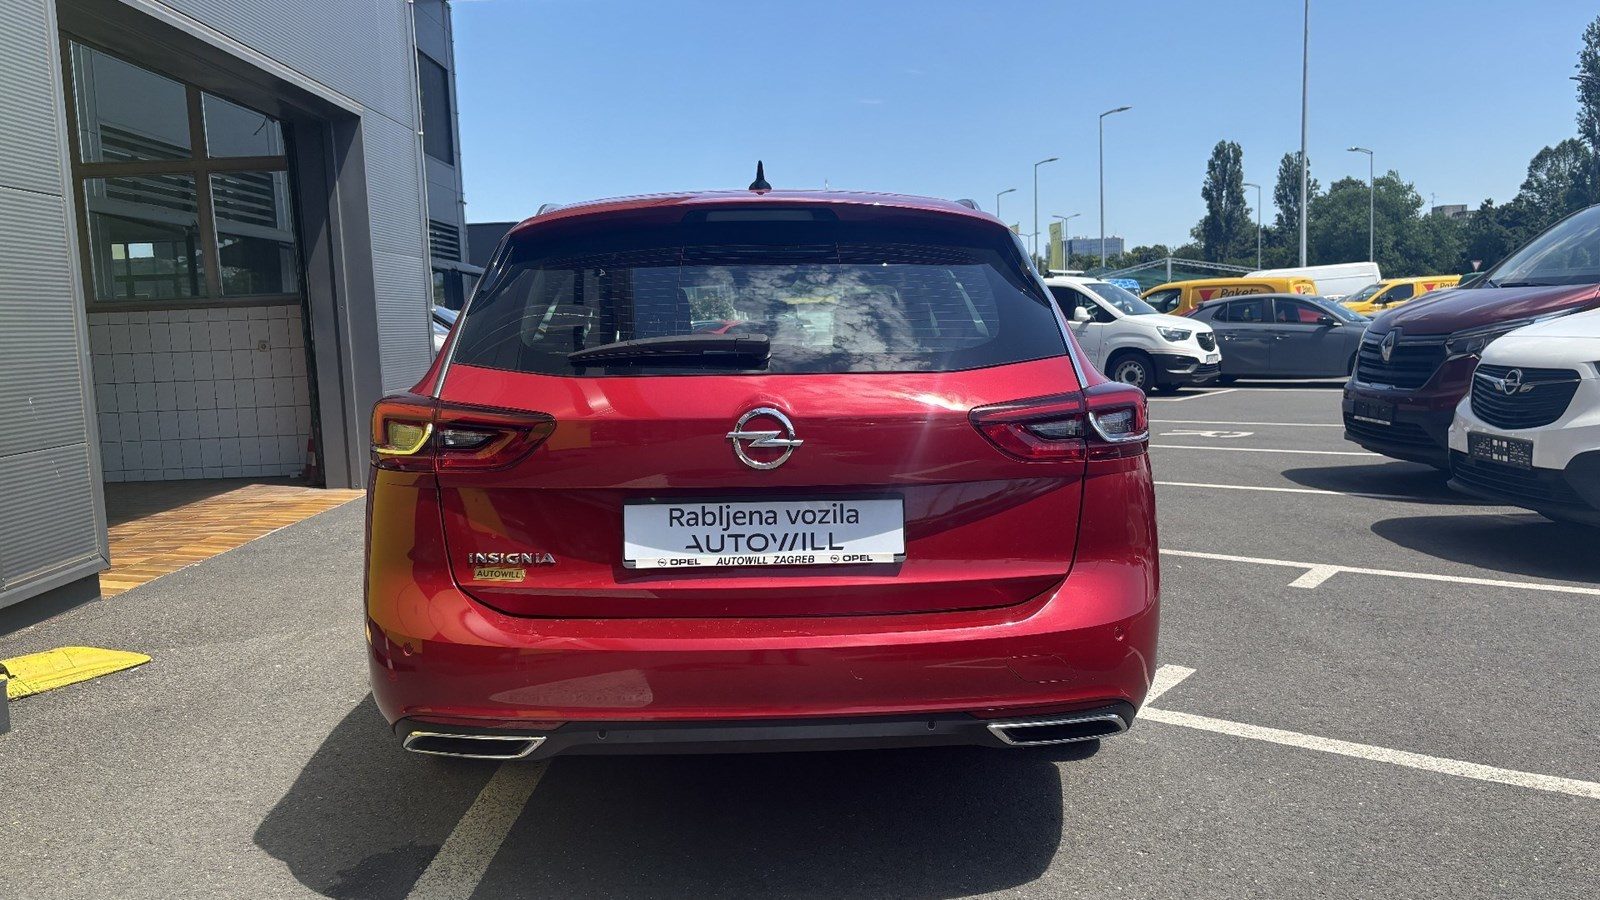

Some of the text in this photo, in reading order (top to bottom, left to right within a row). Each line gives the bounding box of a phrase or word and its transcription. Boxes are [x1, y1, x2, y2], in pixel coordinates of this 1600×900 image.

[669, 503, 859, 531] Rabljena vozila
[685, 532, 844, 553] AUTOWILL
[468, 552, 556, 564] INSIGNIA
[669, 554, 873, 566] OPEL AUTOWILL ZAGREB OPEL
[476, 570, 520, 579] AUTOWILL
